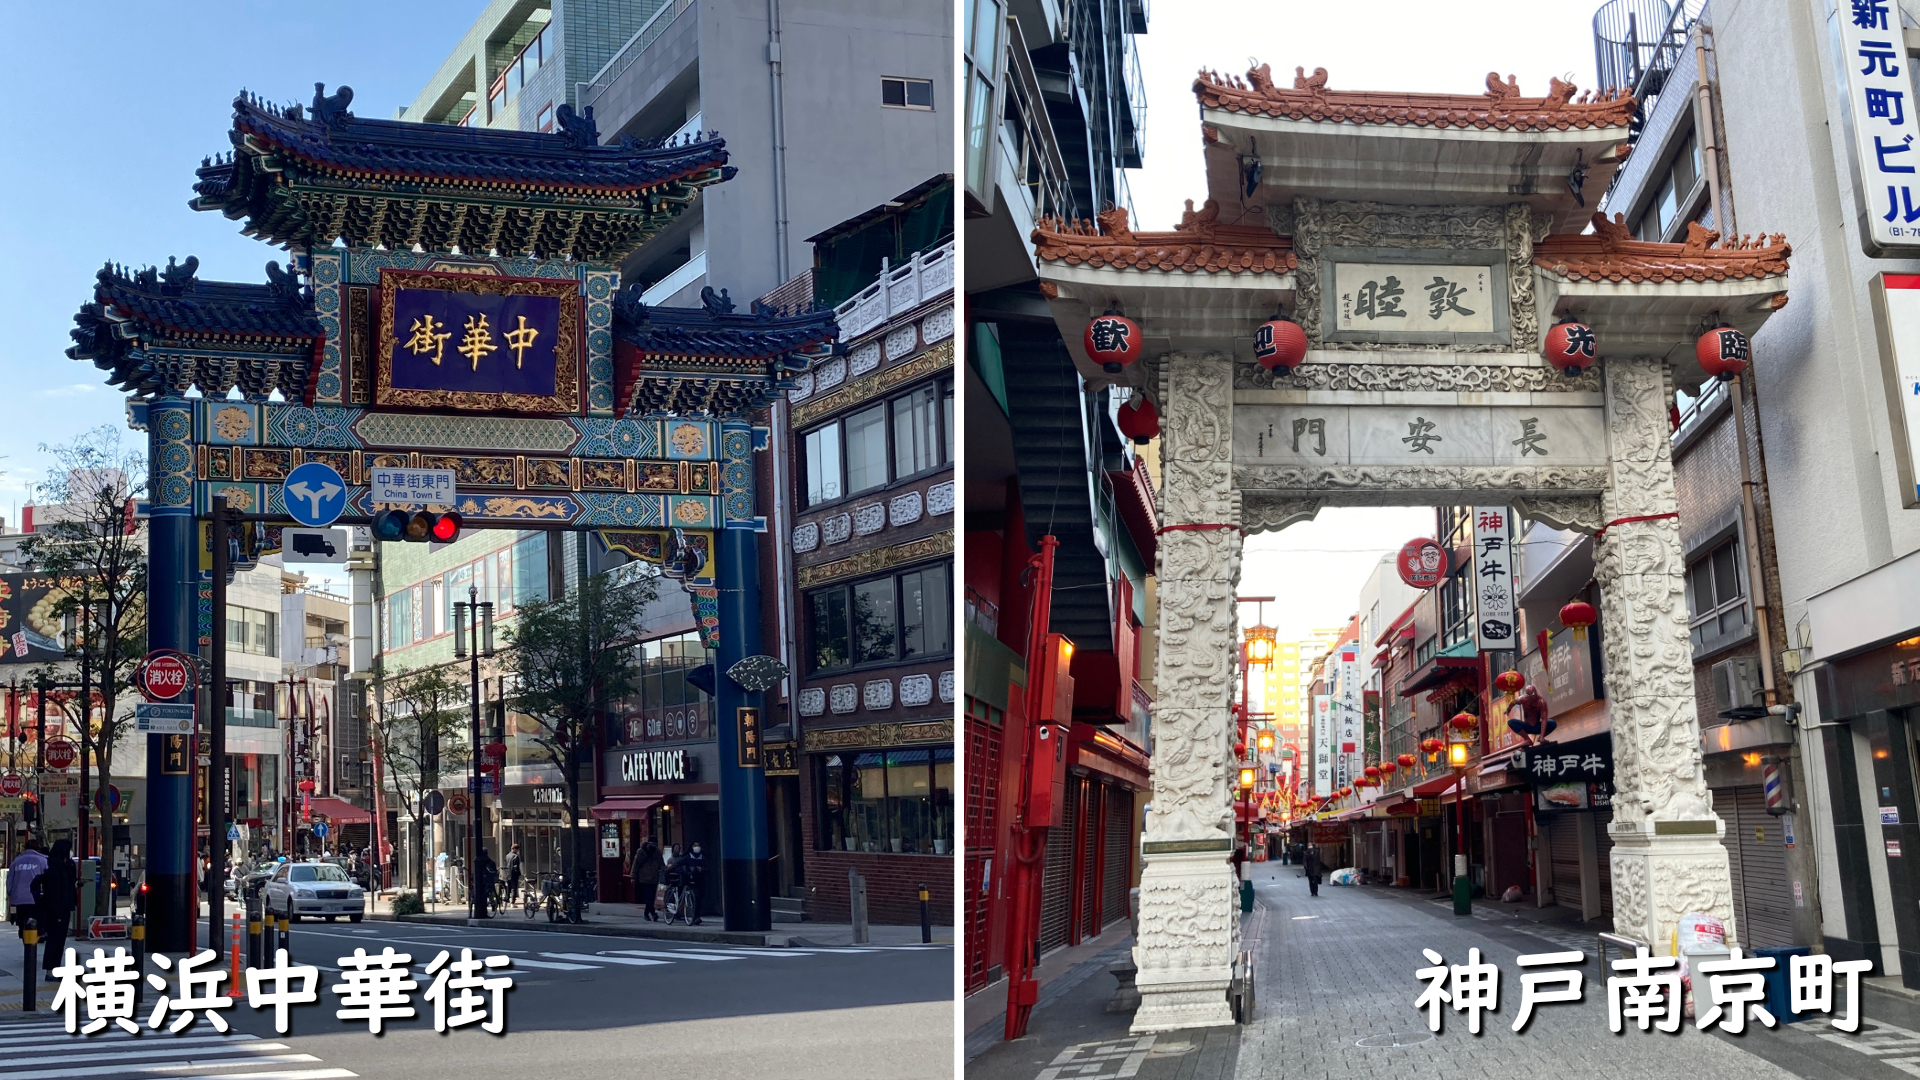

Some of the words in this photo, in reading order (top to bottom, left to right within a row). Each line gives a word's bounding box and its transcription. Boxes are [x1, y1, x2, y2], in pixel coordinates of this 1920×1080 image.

[1563, 324, 1596, 358] 光
[1717, 330, 1748, 362] 臨
[377, 472, 450, 489] 中華街東門
[384, 490, 408, 499] China
[411, 491, 433, 499] Town
[435, 491, 444, 499] E.
[1478, 511, 1506, 582] 神戸牛
[21, 577, 55, 590] ようこそ
[149, 669, 183, 686] 消火栓
[743, 712, 756, 760] 朝陽門
[47, 749, 72, 760] 消火栓
[621, 750, 649, 782] CAFFÈ
[649, 750, 685, 781] VELOCE
[1532, 753, 1606, 778] 神戸牛
[3, 781, 21, 789] 消火栓
